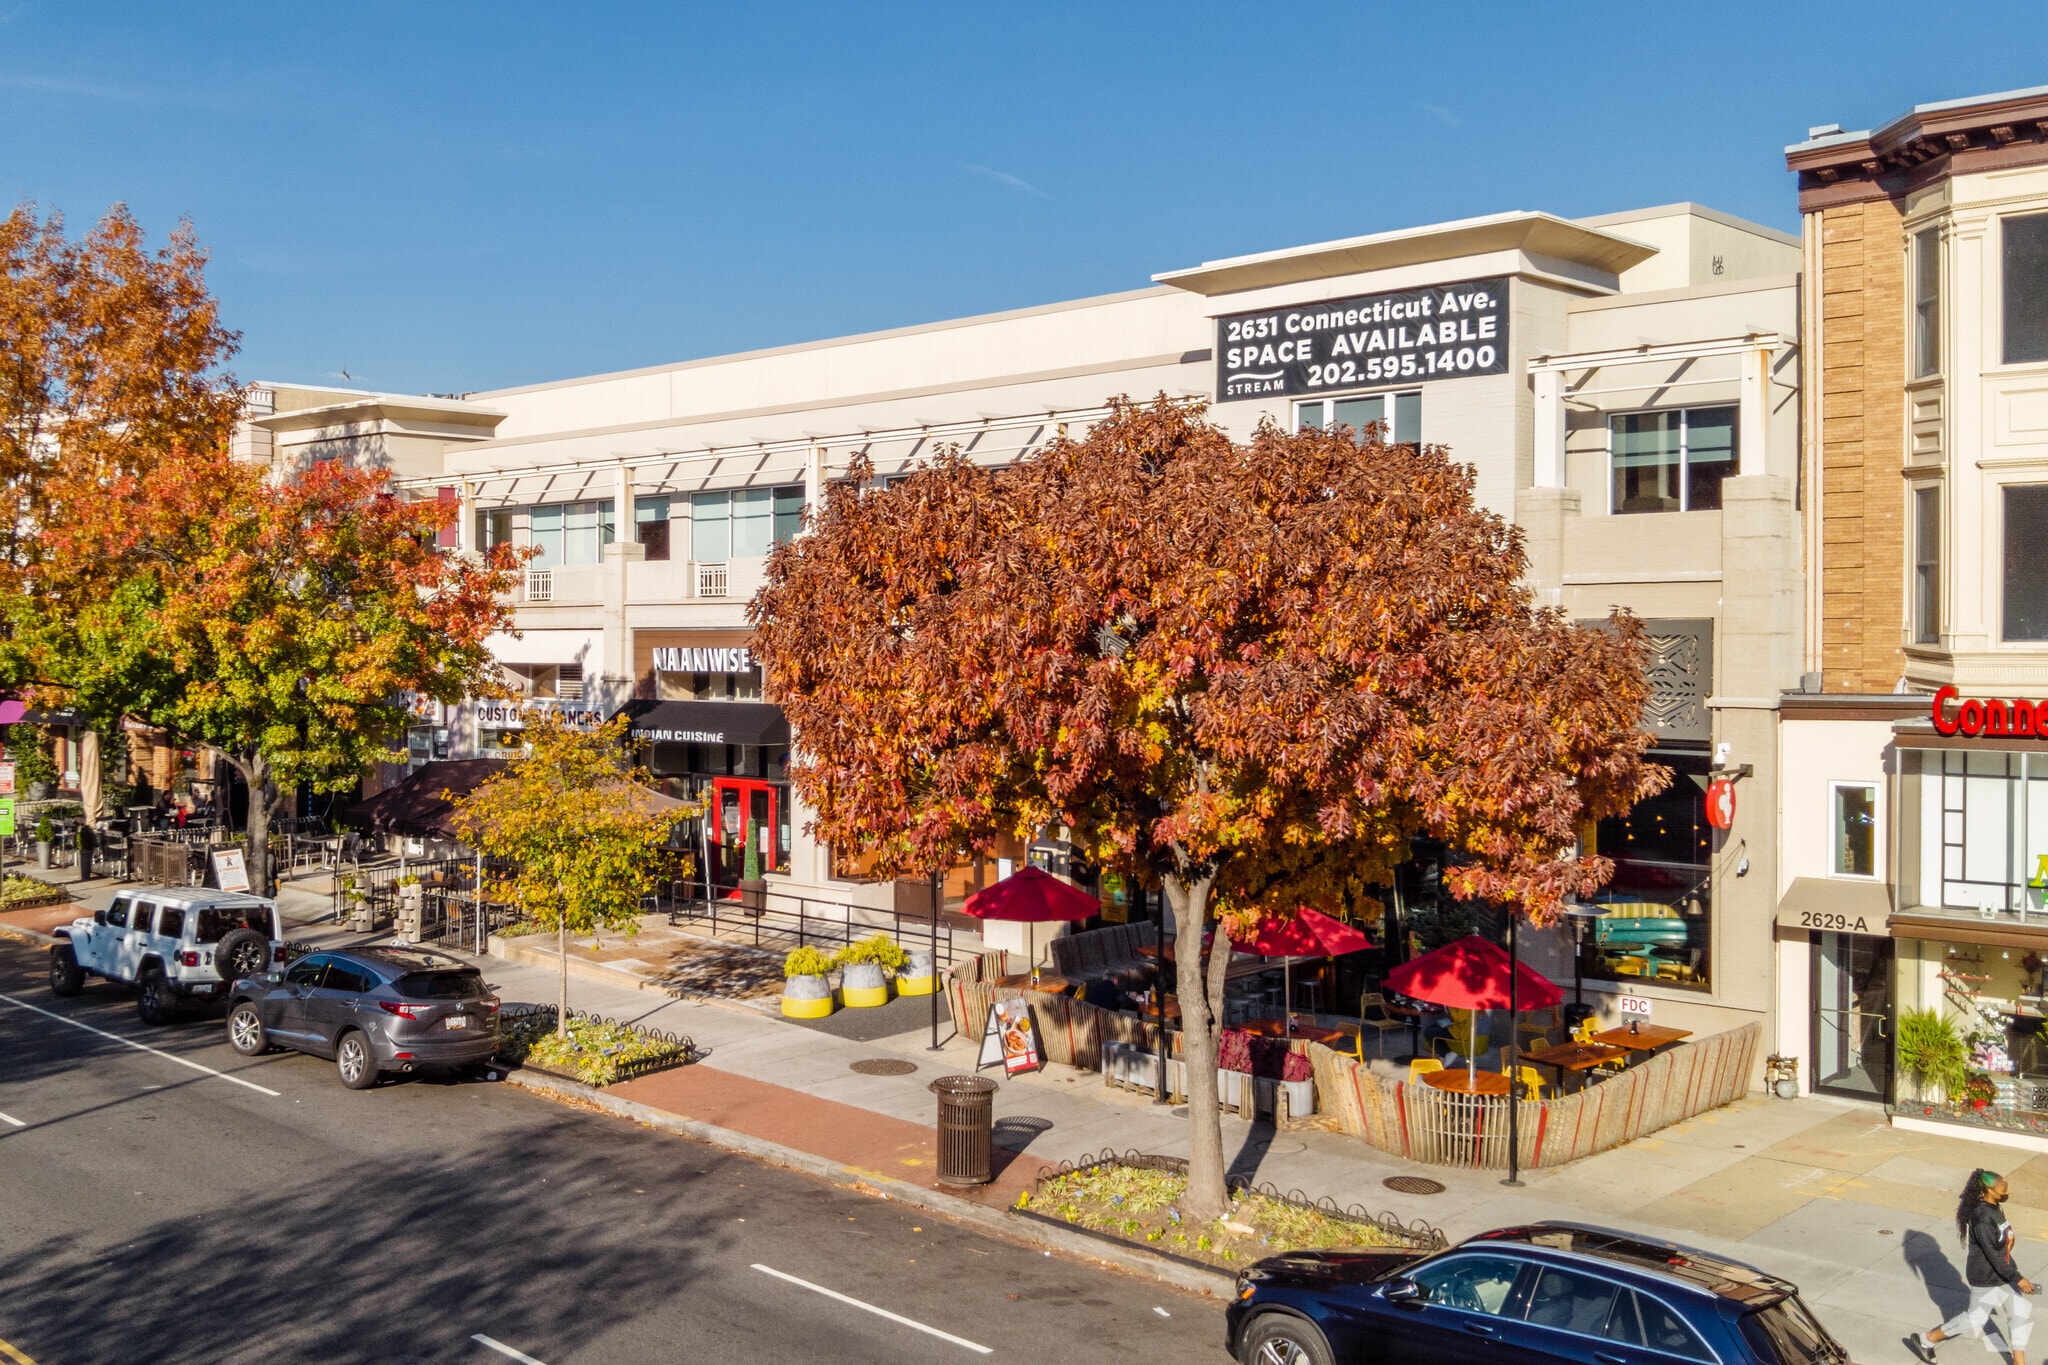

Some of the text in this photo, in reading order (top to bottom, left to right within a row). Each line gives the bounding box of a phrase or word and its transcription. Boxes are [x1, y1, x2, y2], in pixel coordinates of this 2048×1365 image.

[1228, 292, 1496, 342] 2631 Connecticut Ave.
[1227, 315, 1497, 369] SPACE AVAILABLE
[1307, 345, 1496, 387] 202.595.1400
[1227, 379, 1285, 396] STREAM
[653, 647, 750, 673] NAANWISE
[537, 708, 602, 726] LANERS
[631, 728, 724, 743] INDIAN CUISINE
[1800, 910, 1870, 933] 2629-A
[1621, 997, 1648, 1014] FDC
